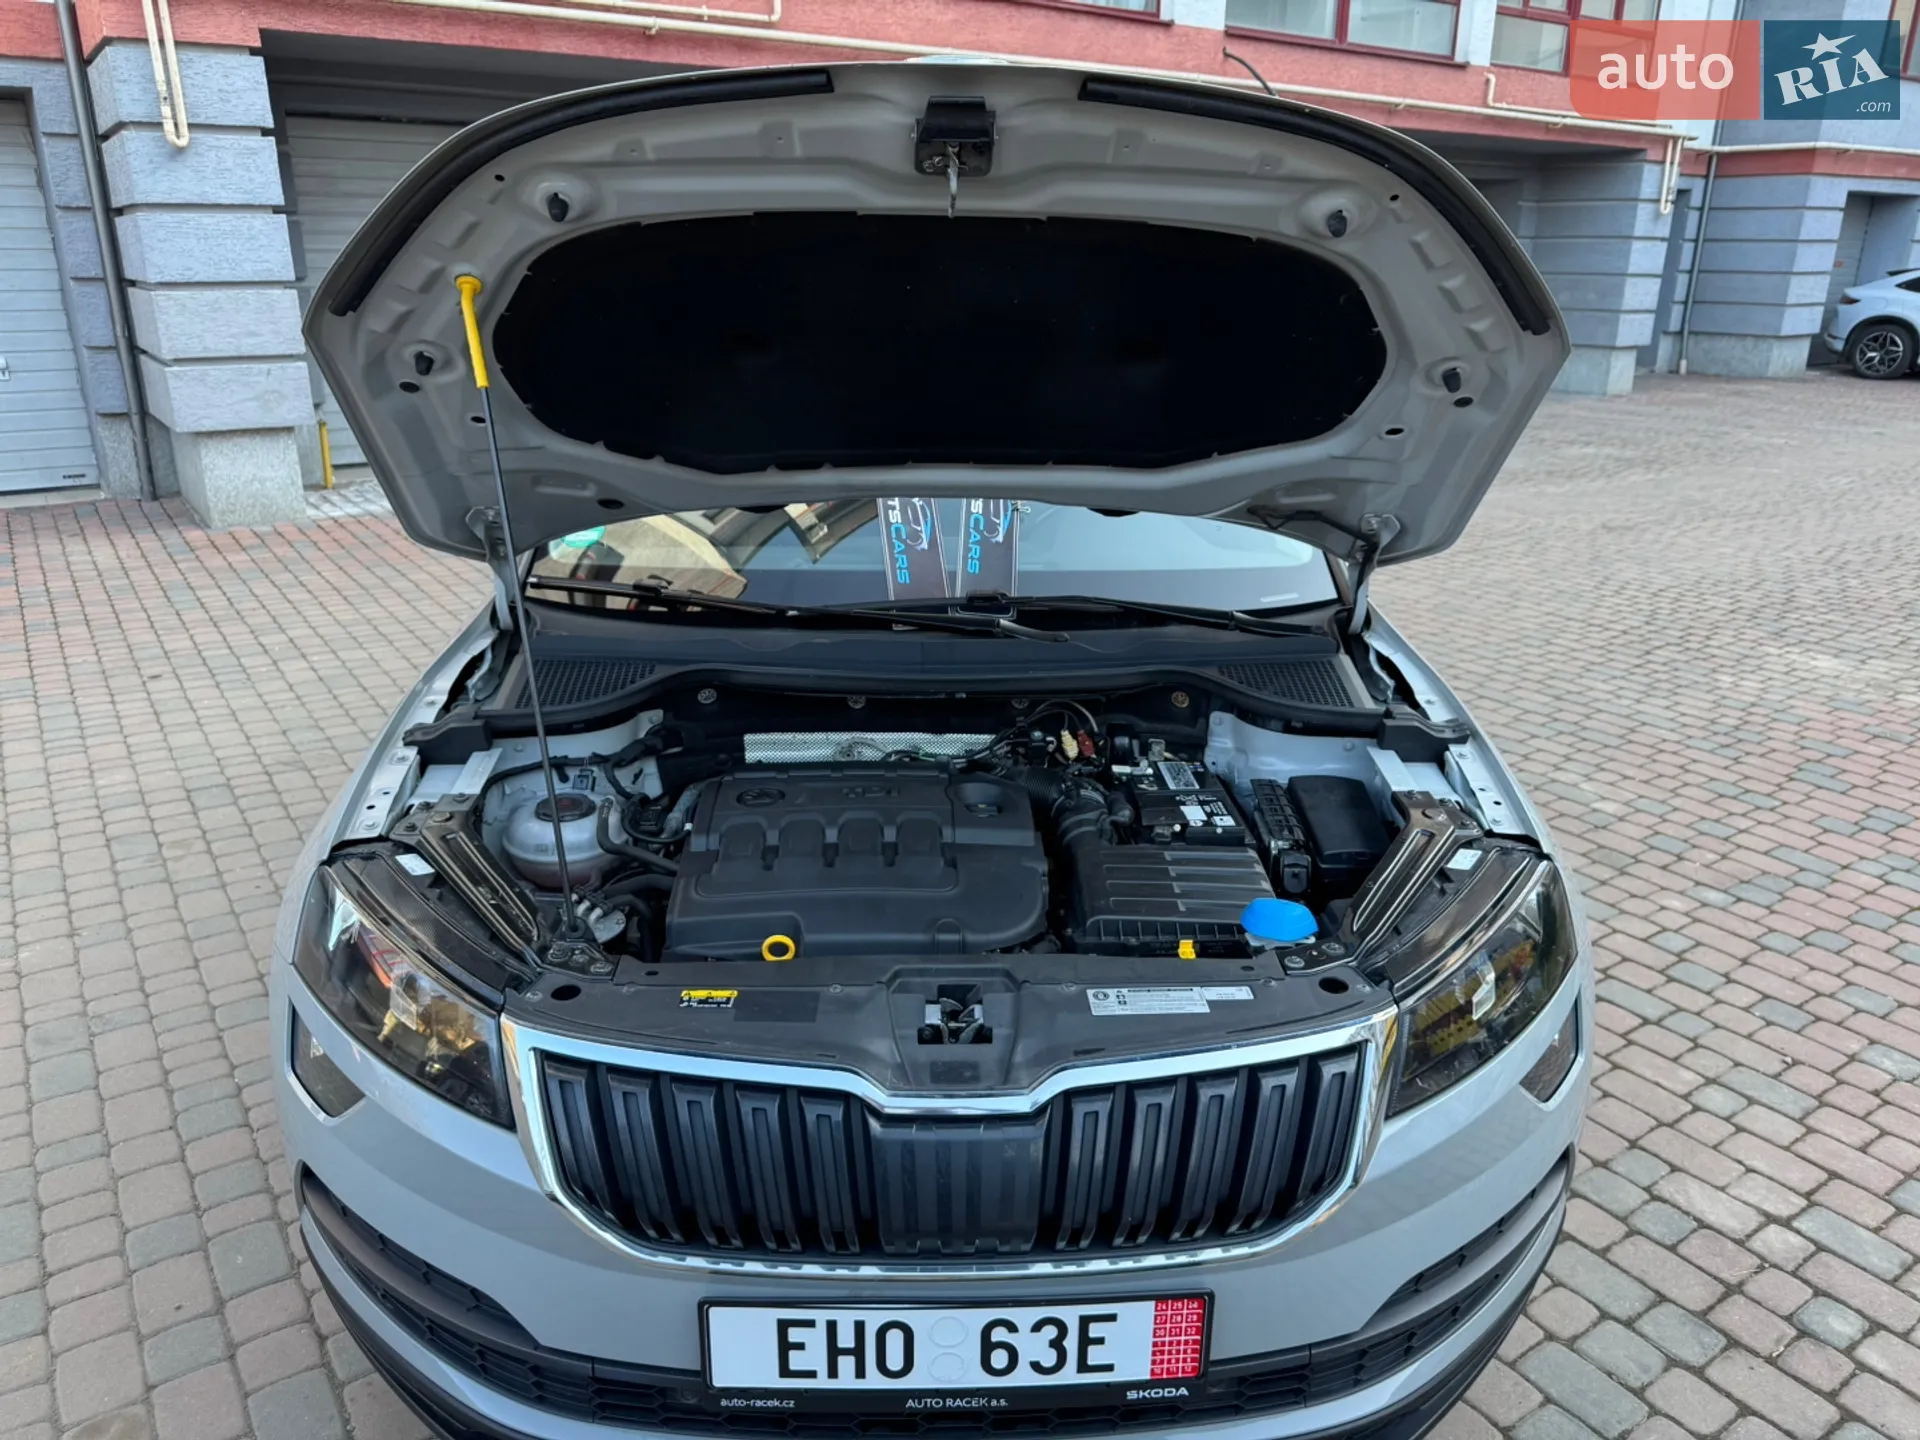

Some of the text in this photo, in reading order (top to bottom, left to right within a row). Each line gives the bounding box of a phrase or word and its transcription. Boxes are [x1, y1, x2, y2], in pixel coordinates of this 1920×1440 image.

[980, 1313, 1118, 1378] 63E
[720, 1398, 795, 1408] auto-racek.cz
[905, 1398, 943, 1408] AUTO
[945, 1397, 988, 1408] RACEK
